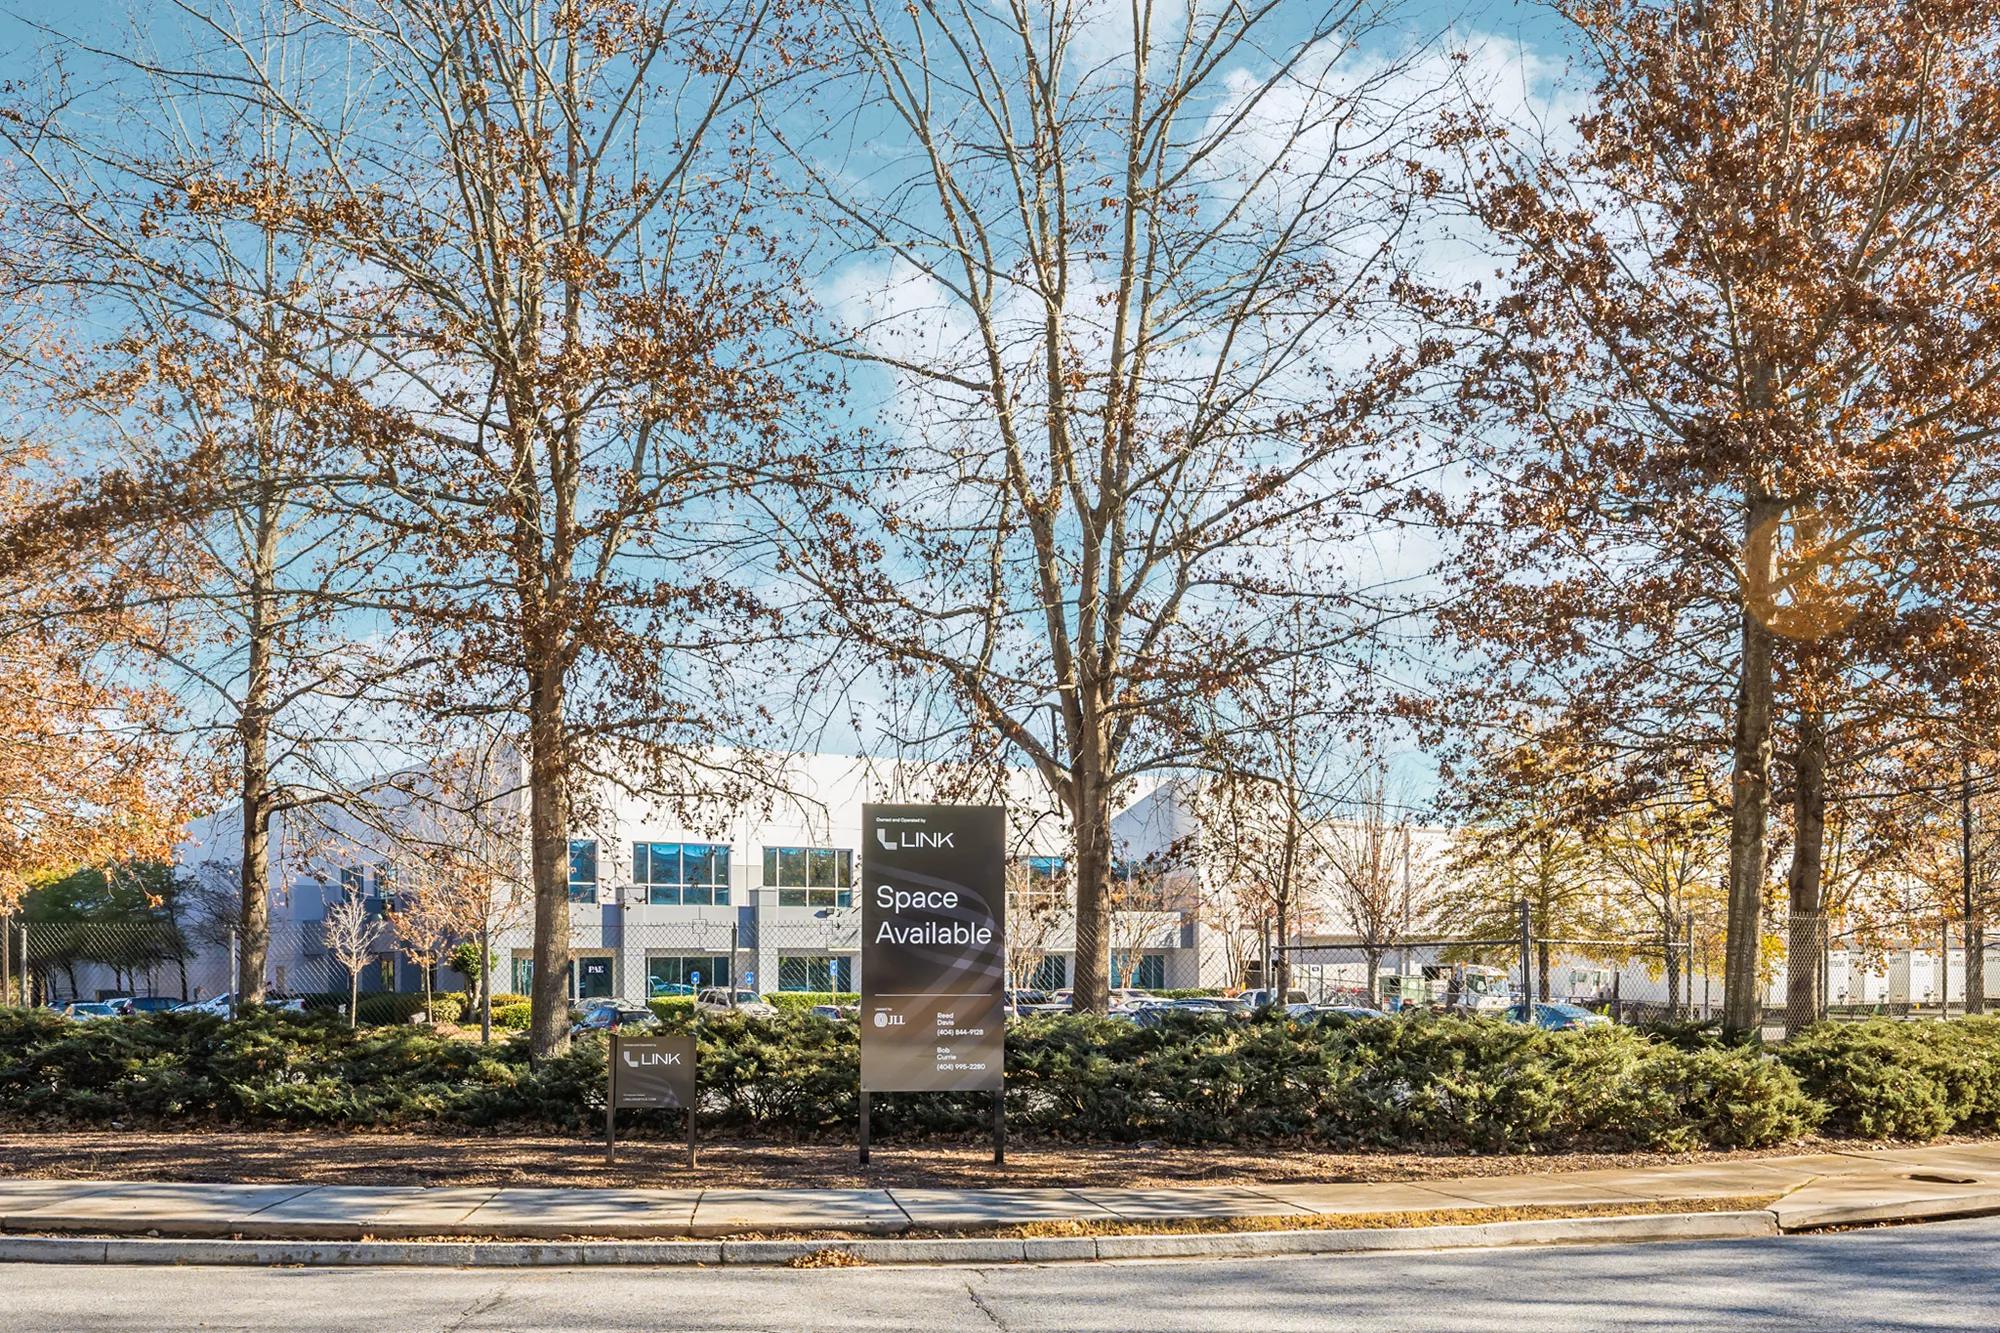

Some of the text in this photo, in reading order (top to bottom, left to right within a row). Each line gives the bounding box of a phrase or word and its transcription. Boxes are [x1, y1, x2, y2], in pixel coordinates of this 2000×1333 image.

[901, 831, 955, 848] LINK
[876, 885, 958, 914] Space
[875, 921, 992, 945] Available
[888, 1015, 906, 1025] JLL
[937, 1029, 954, 1037] (404)
[641, 1053, 681, 1065] LINK
[936, 1063, 954, 1071] (404)
